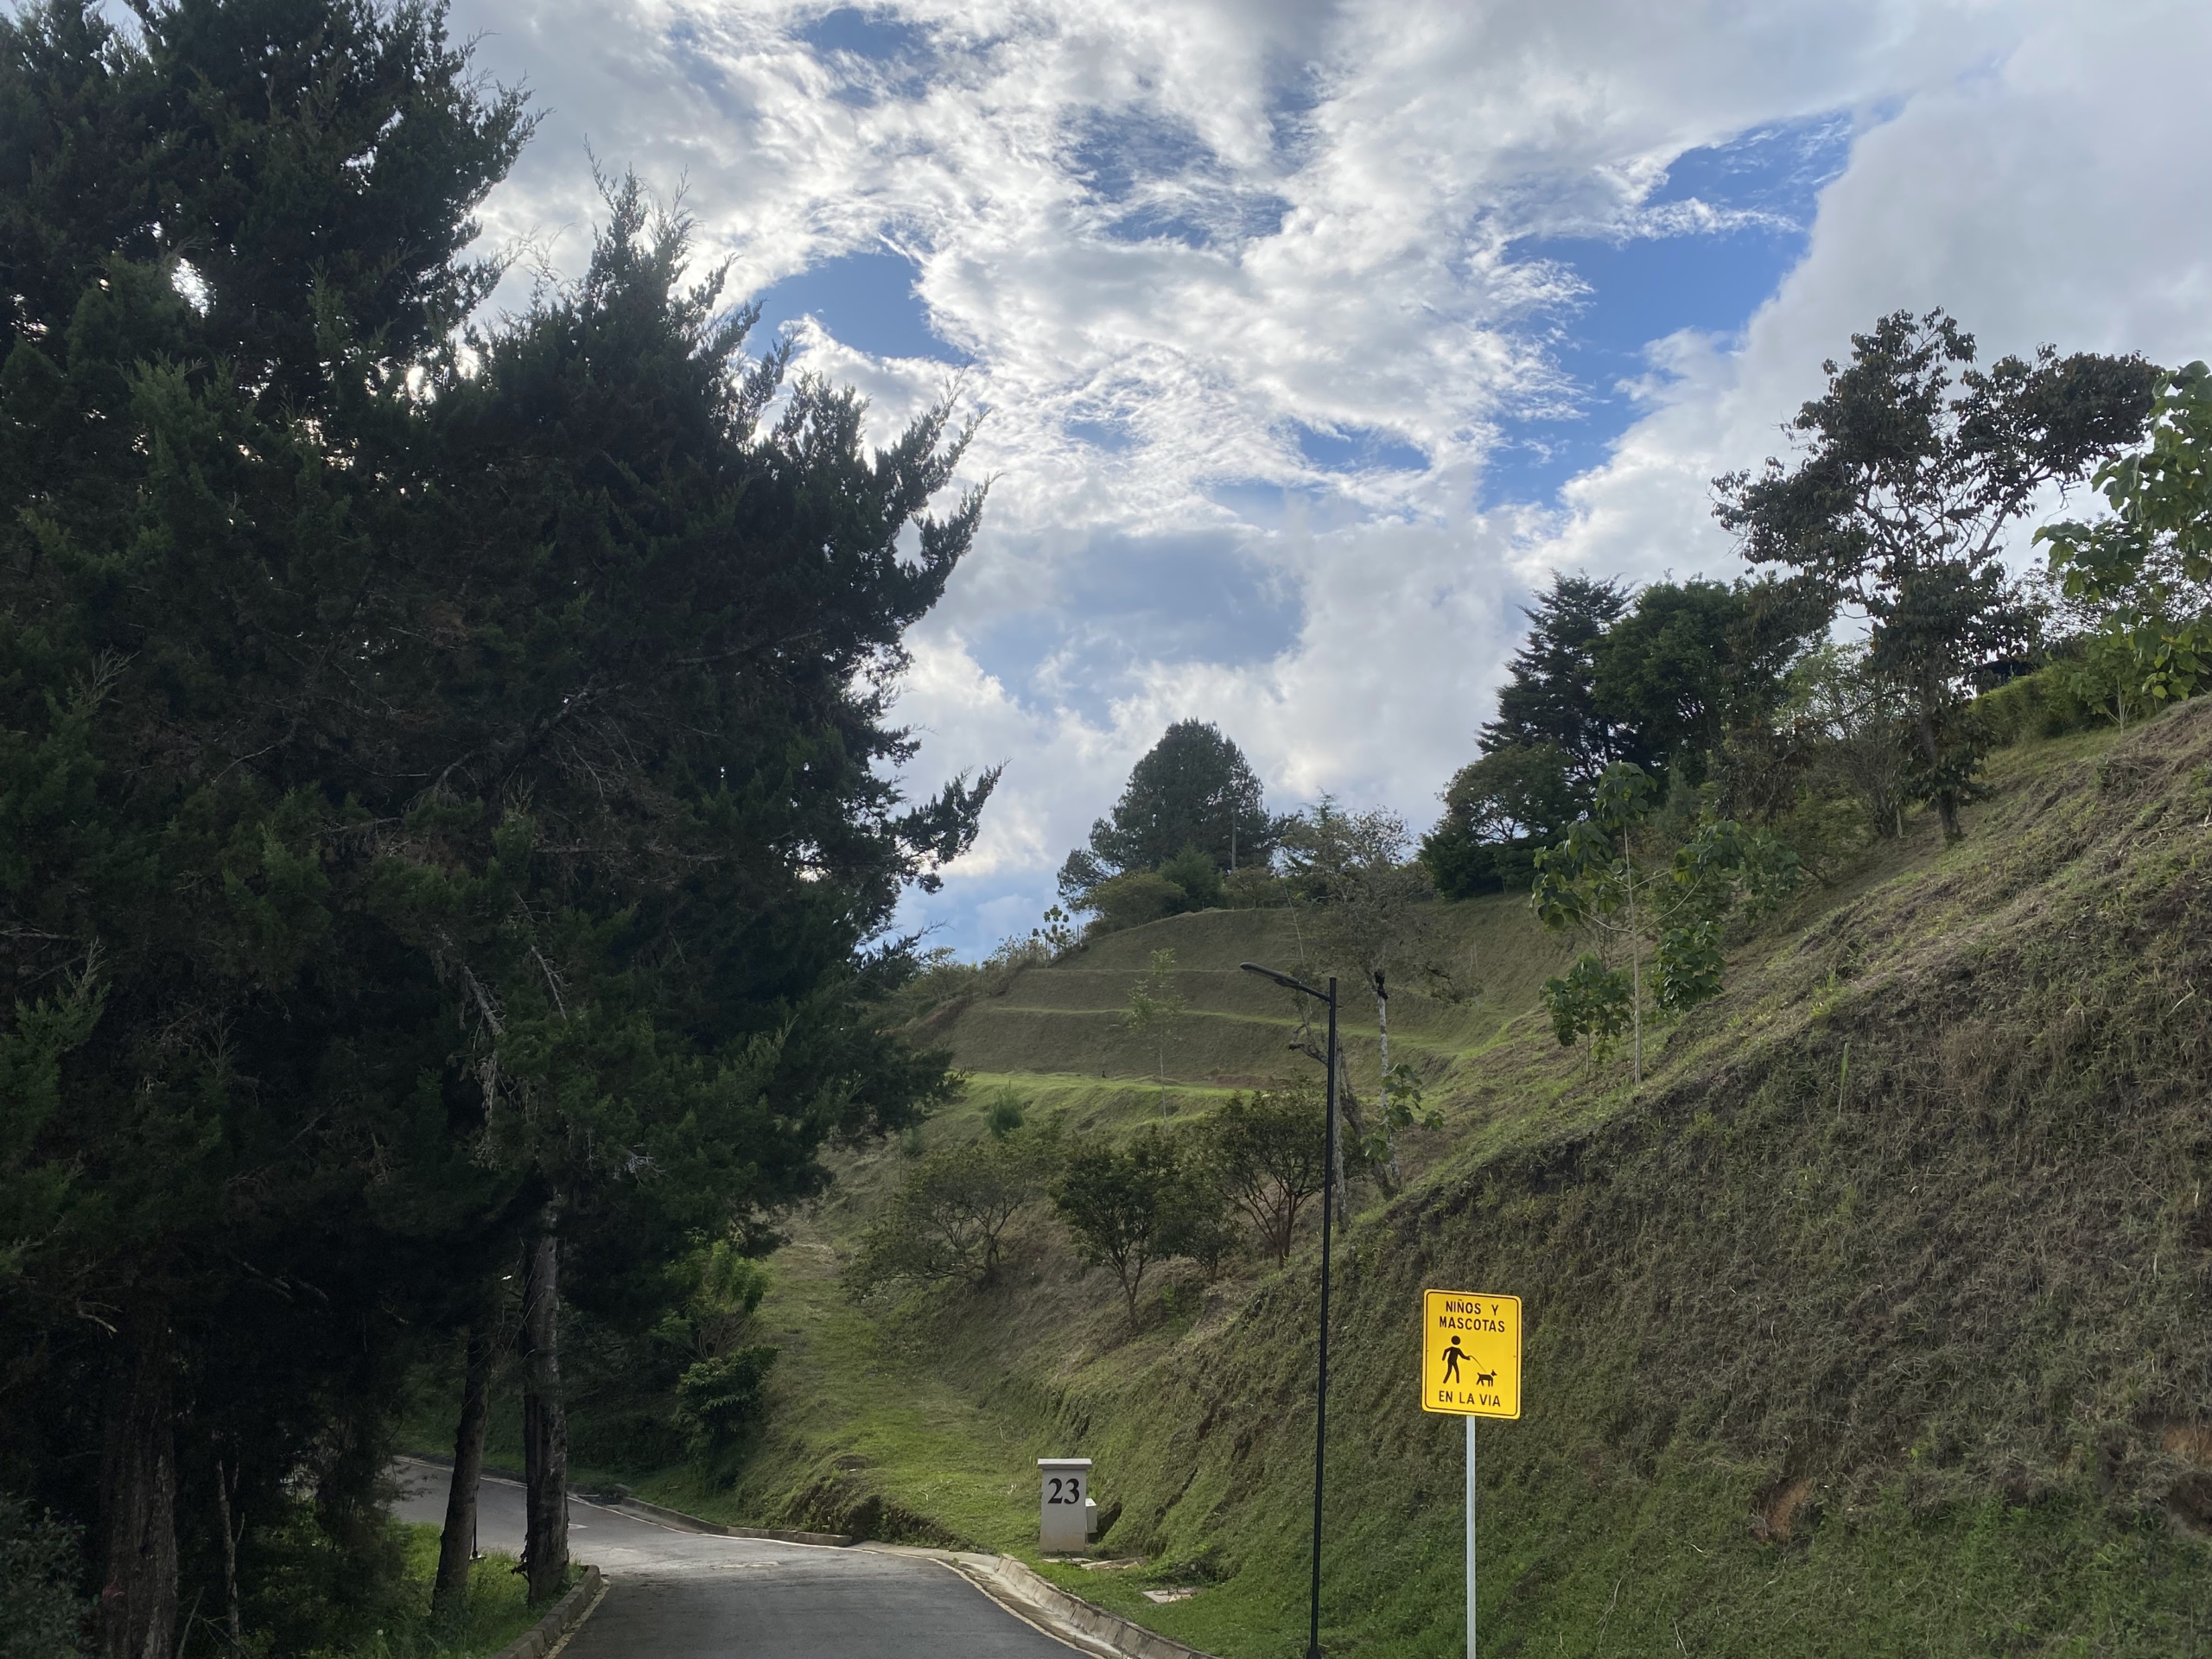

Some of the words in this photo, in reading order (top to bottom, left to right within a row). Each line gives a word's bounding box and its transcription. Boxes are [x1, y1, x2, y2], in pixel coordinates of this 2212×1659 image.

[1446, 1299, 1481, 1315] NIÑOS
[1491, 1304, 1499, 1316] Y
[1440, 1316, 1505, 1332] MASCOTAS
[1439, 1390, 1453, 1403] EN
[1459, 1392, 1475, 1405] LA
[1479, 1394, 1501, 1407] VIA
[1047, 1478, 1080, 1504] 23
